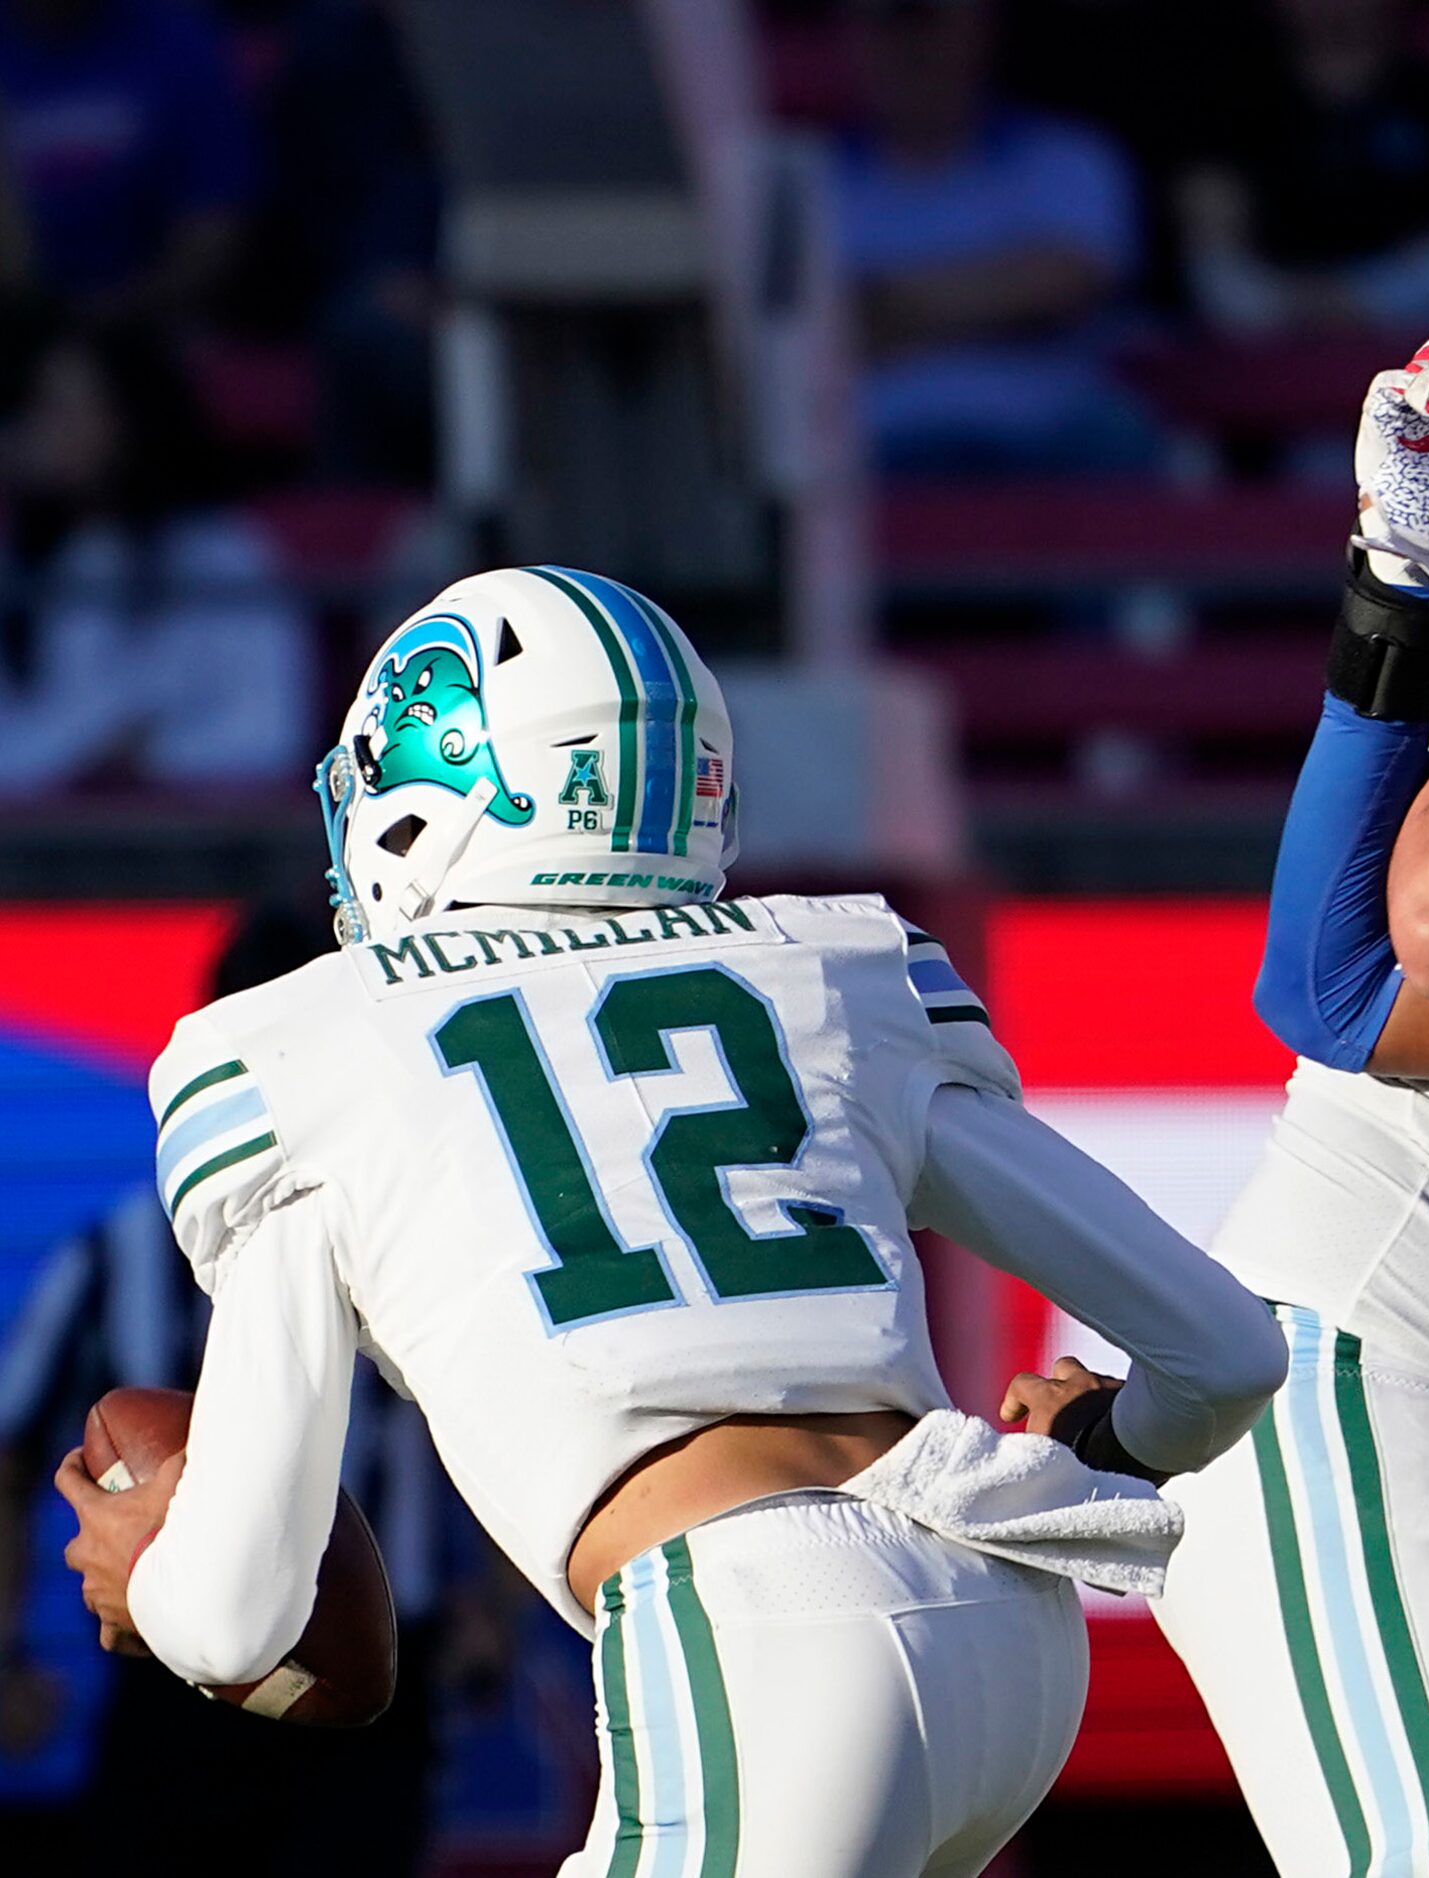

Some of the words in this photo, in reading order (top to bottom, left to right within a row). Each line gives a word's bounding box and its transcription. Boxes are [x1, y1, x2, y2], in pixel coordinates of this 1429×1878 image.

[567, 809, 598, 830] P6
[529, 872, 652, 888] GREEN
[367, 900, 757, 985] MCMILLAN
[426, 961, 898, 1339] 12
